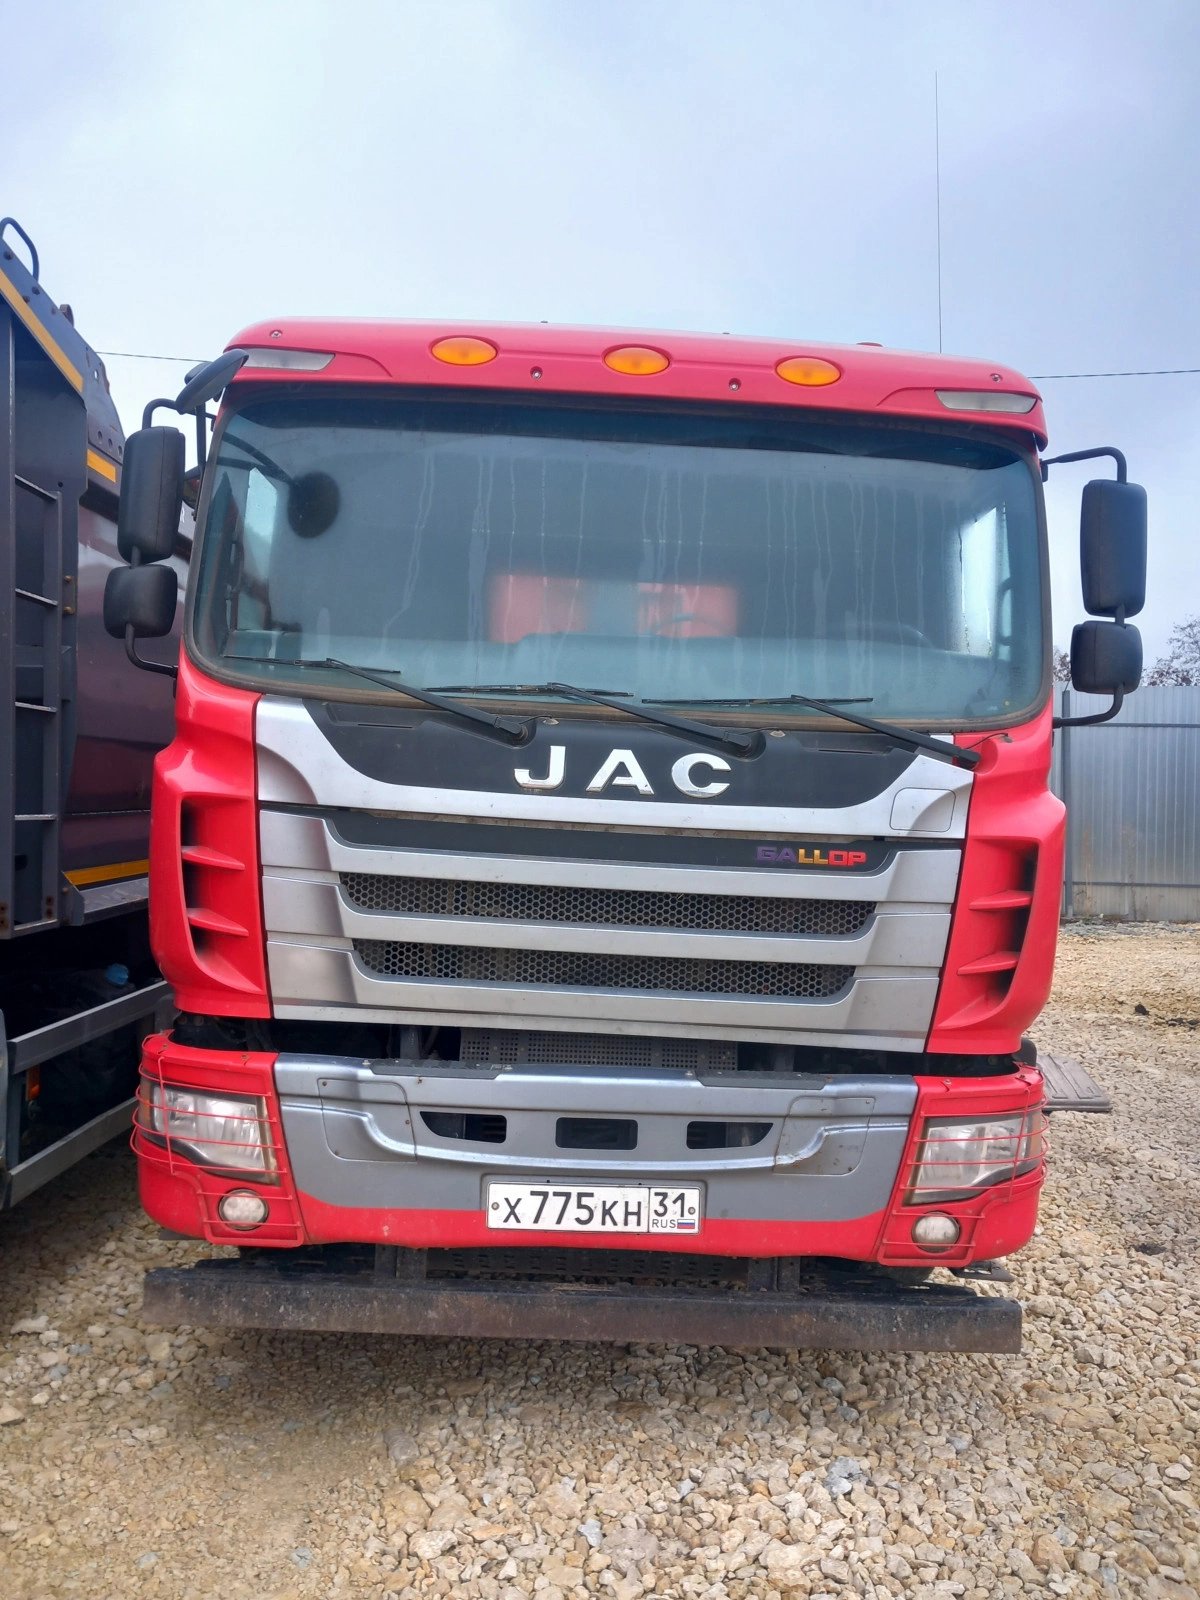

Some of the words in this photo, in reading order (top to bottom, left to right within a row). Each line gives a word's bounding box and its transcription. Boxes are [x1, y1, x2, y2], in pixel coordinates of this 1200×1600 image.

[514, 745, 731, 799] JAC
[757, 846, 867, 866] GALLOP
[653, 1191, 686, 1218] 31
[651, 1218, 676, 1229] RUS
